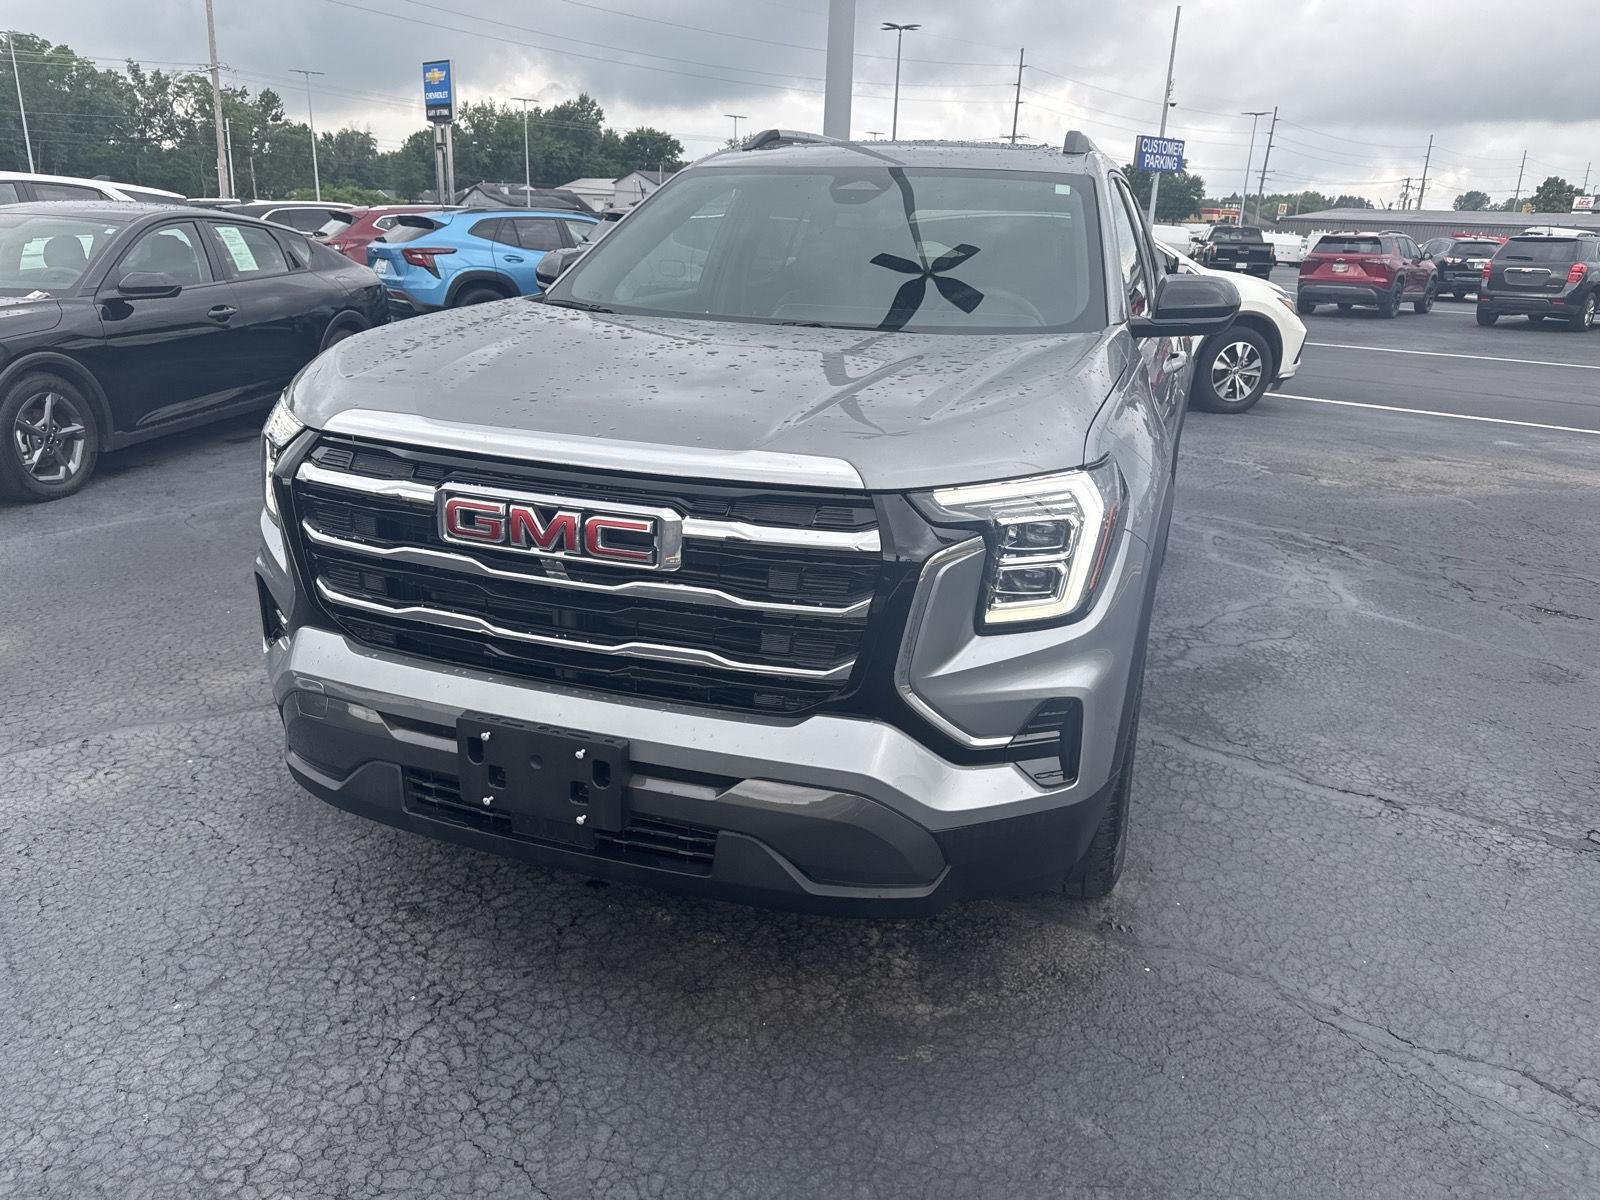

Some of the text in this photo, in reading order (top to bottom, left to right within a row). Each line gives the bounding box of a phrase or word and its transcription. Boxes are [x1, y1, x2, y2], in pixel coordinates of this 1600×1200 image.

[426, 91, 448, 99] CHEVROLET
[1141, 138, 1183, 156] CUSTOMER
[1144, 153, 1178, 170] PARKING
[445, 497, 653, 563] GMC
